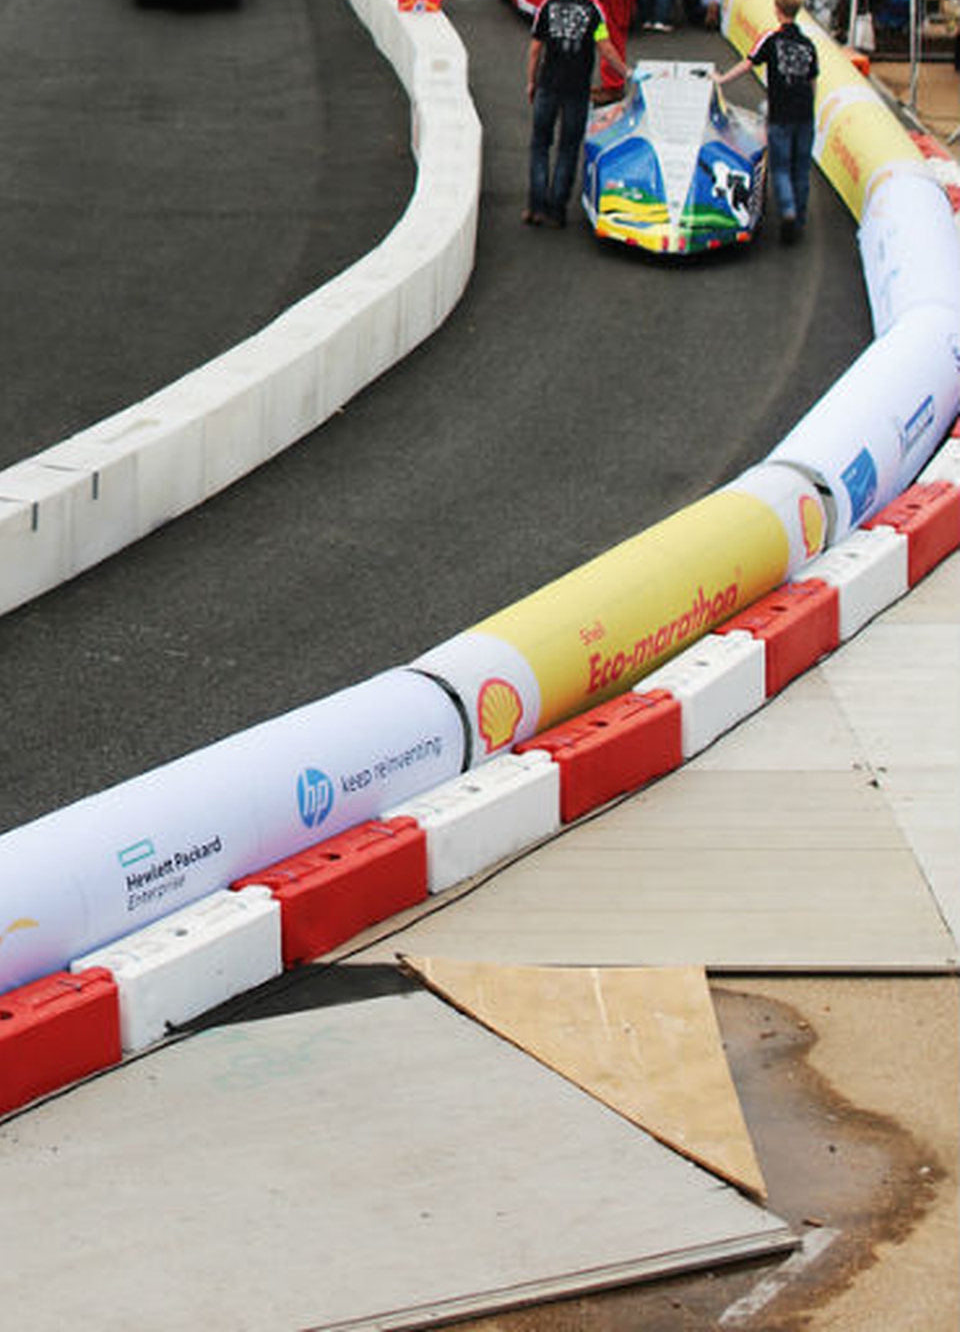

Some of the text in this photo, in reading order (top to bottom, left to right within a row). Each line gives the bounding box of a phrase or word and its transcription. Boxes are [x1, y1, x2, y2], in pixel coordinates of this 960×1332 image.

[587, 583, 739, 695] Eco-marathon
[297, 768, 334, 828] hp
[340, 769, 372, 794] keep
[125, 835, 222, 891] Hewlett Packard
